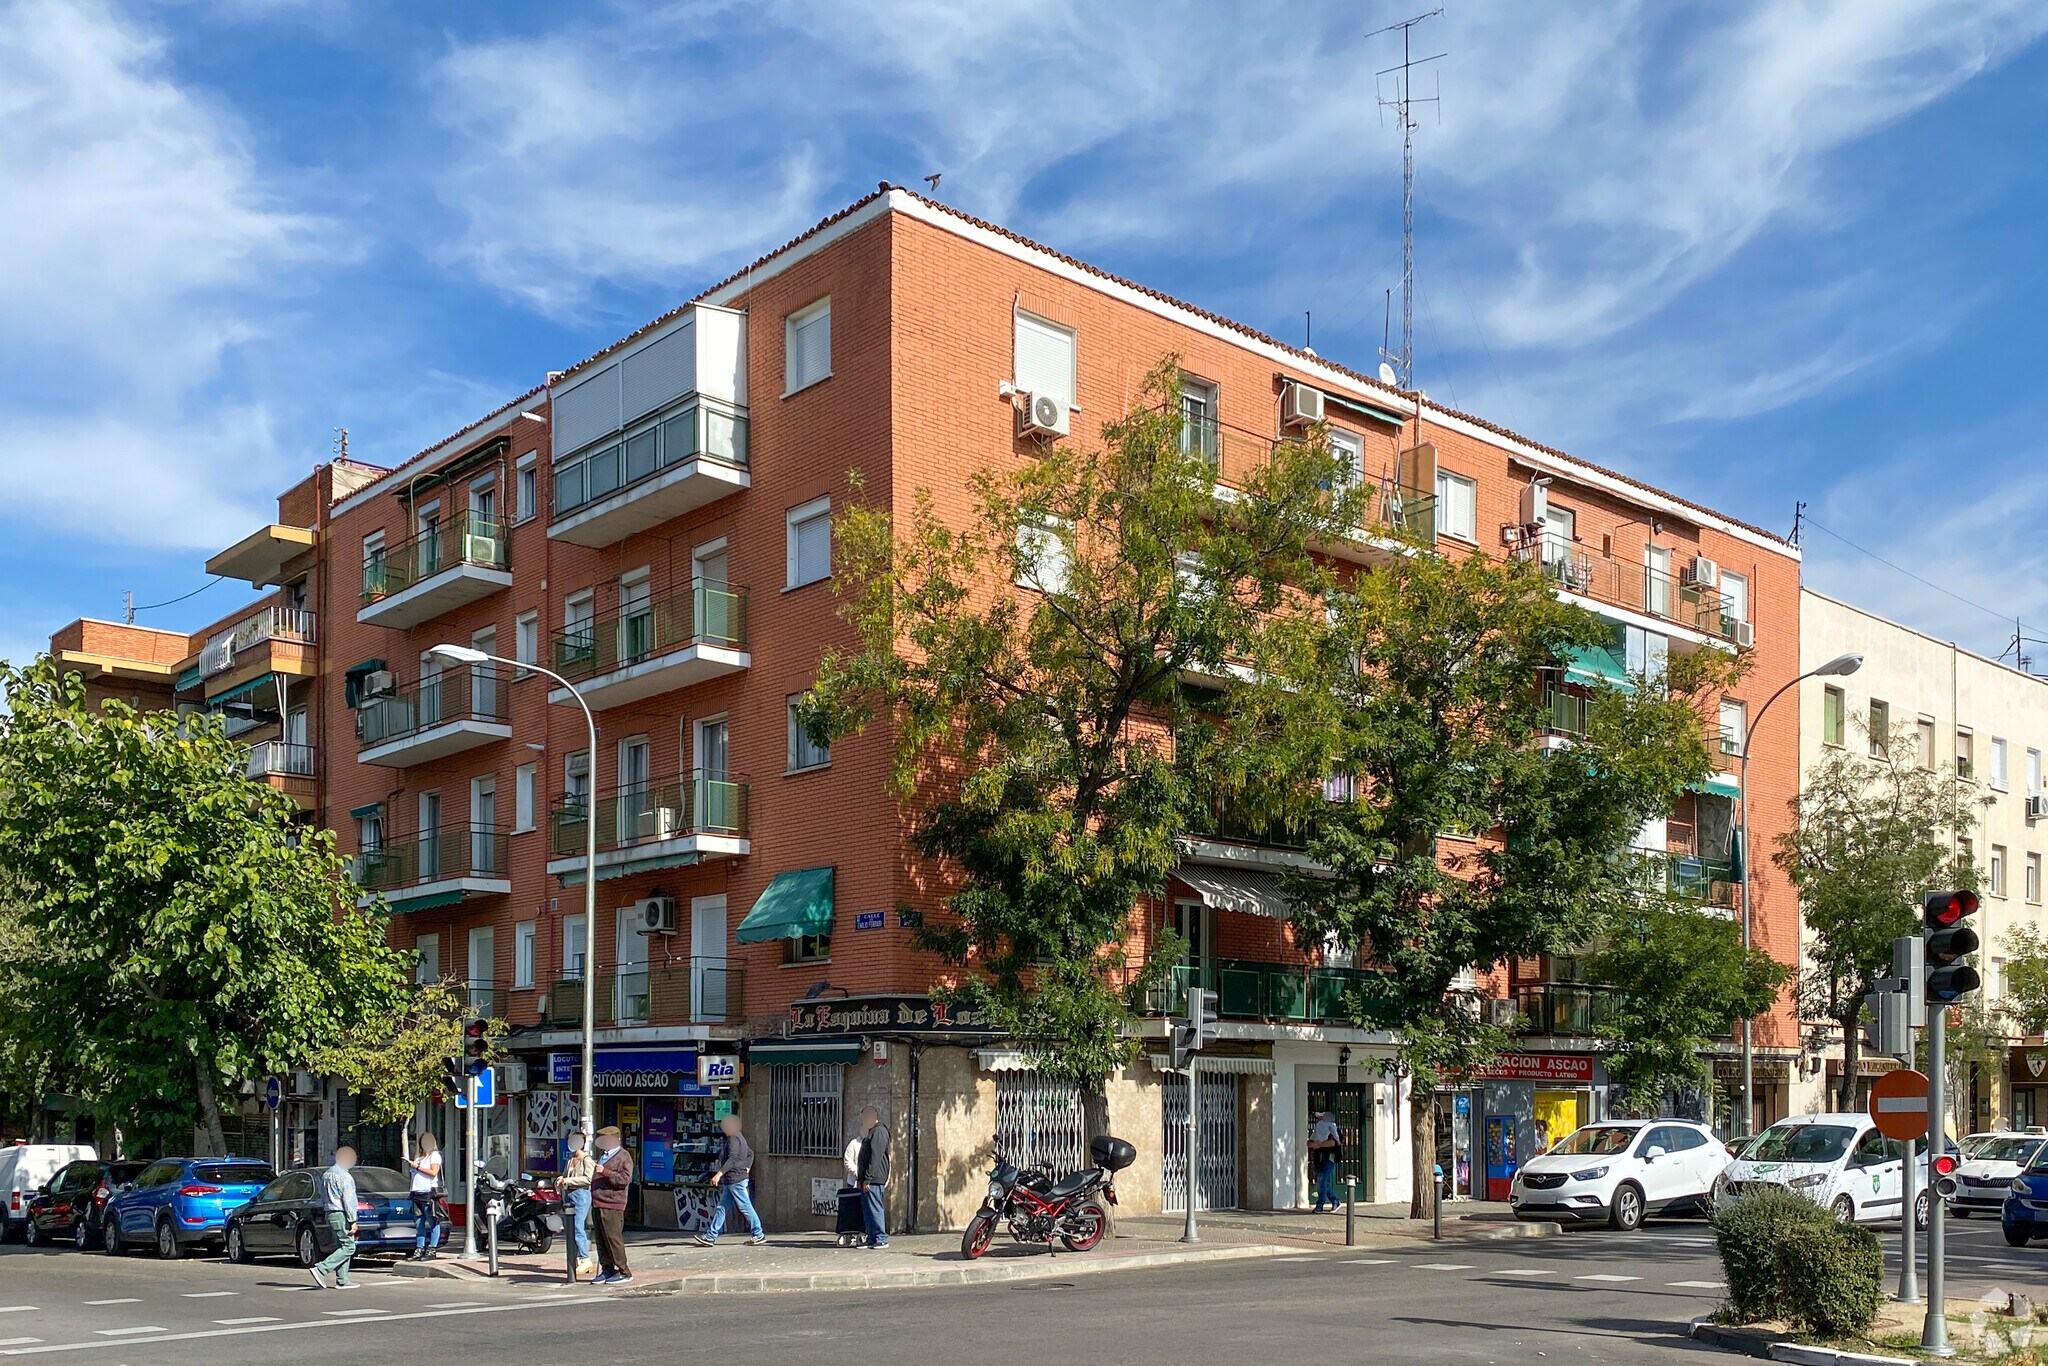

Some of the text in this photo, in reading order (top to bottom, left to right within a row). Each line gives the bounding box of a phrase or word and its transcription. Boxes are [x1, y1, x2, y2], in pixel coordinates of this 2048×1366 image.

[791, 1006, 815, 1032] La
[816, 1005, 890, 1032] Esquina
[897, 1003, 927, 1025] de
[708, 1058, 734, 1076] Ria
[1547, 1059, 1588, 1071] ASCAO
[592, 1073, 669, 1087] CUTORIO ASCAO
[1519, 1070, 1552, 1078] PRODUCTO
[1555, 1071, 1578, 1079] LATINO
